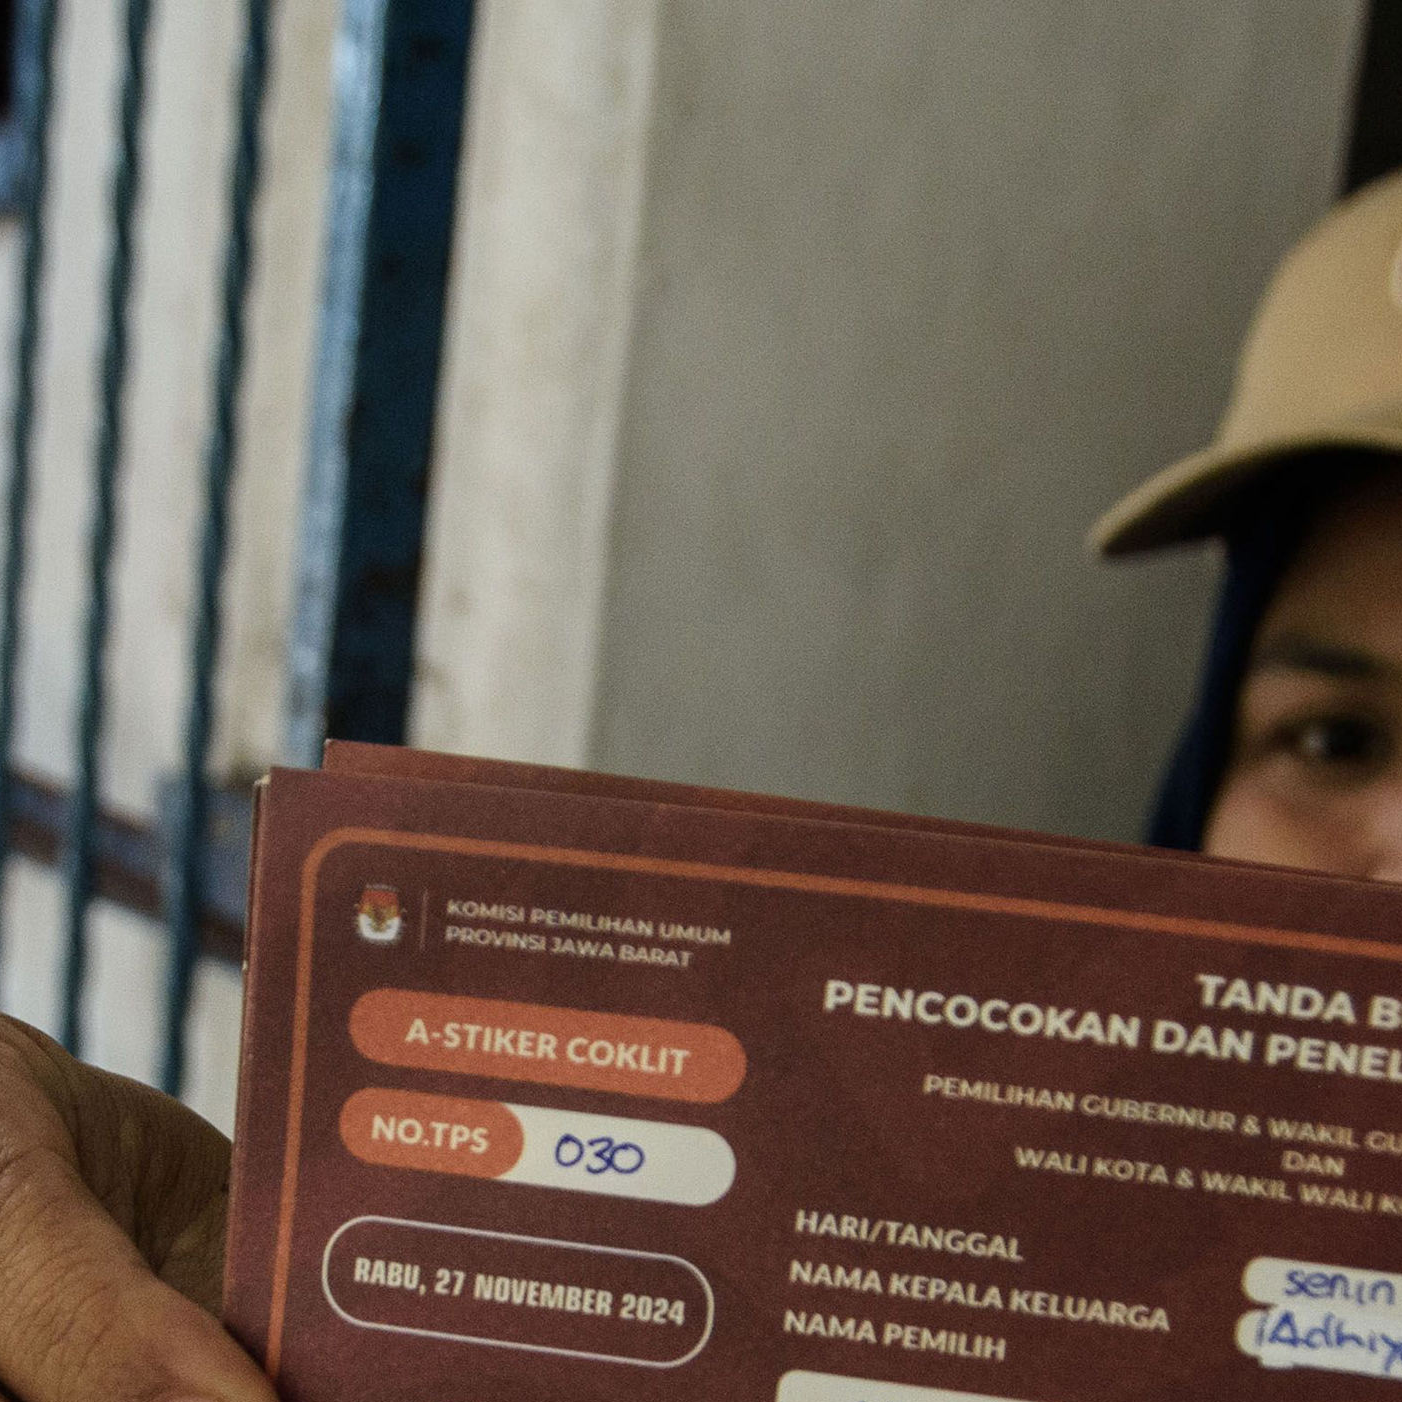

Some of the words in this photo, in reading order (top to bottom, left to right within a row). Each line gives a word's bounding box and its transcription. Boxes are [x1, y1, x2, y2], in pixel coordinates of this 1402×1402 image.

[445, 925, 547, 952] PROVINSI
[550, 937, 615, 960] JAWA
[618, 944, 694, 968] BARAT
[446, 899, 526, 923] KOMISI
[529, 907, 654, 938] PEMILIHAN
[658, 921, 732, 945] UMUM
[823, 978, 1140, 1049] PENCOCOKAN
[1152, 1021, 1254, 1062] DAN
[1198, 973, 1356, 1026] TANDA
[405, 1018, 558, 1063] A-STIKER
[566, 1035, 691, 1077] COKLIT
[370, 1113, 490, 1156] NO.TPS
[922, 1072, 1075, 1115] PEMILIHAN
[1079, 1094, 1236, 1134] GUBERNUR
[1240, 1114, 1262, 1136] &
[1267, 1117, 1358, 1149] WAKIL
[553, 1132, 646, 1175] 030
[1013, 1146, 1087, 1176] WALI
[1093, 1156, 1169, 1187] KOTA
[1174, 1165, 1195, 1189] &
[1201, 1169, 1293, 1202] WAKIL
[1299, 1182, 1374, 1212] WALI
[1281, 1149, 1346, 1178] DAN
[794, 1208, 1025, 1264] HARI/TANGGAL
[353, 1256, 428, 1298] RABU,
[435, 1268, 465, 1297] 27
[473, 1271, 613, 1318] NOVEMBER
[620, 1290, 686, 1326] 2024
[788, 1258, 882, 1295] NAMA
[888, 1272, 1003, 1311] KEPALA
[1009, 1288, 1172, 1333] KELUARGA
[782, 1308, 876, 1344] NAMA
[882, 1321, 1007, 1363] PEMILIH
